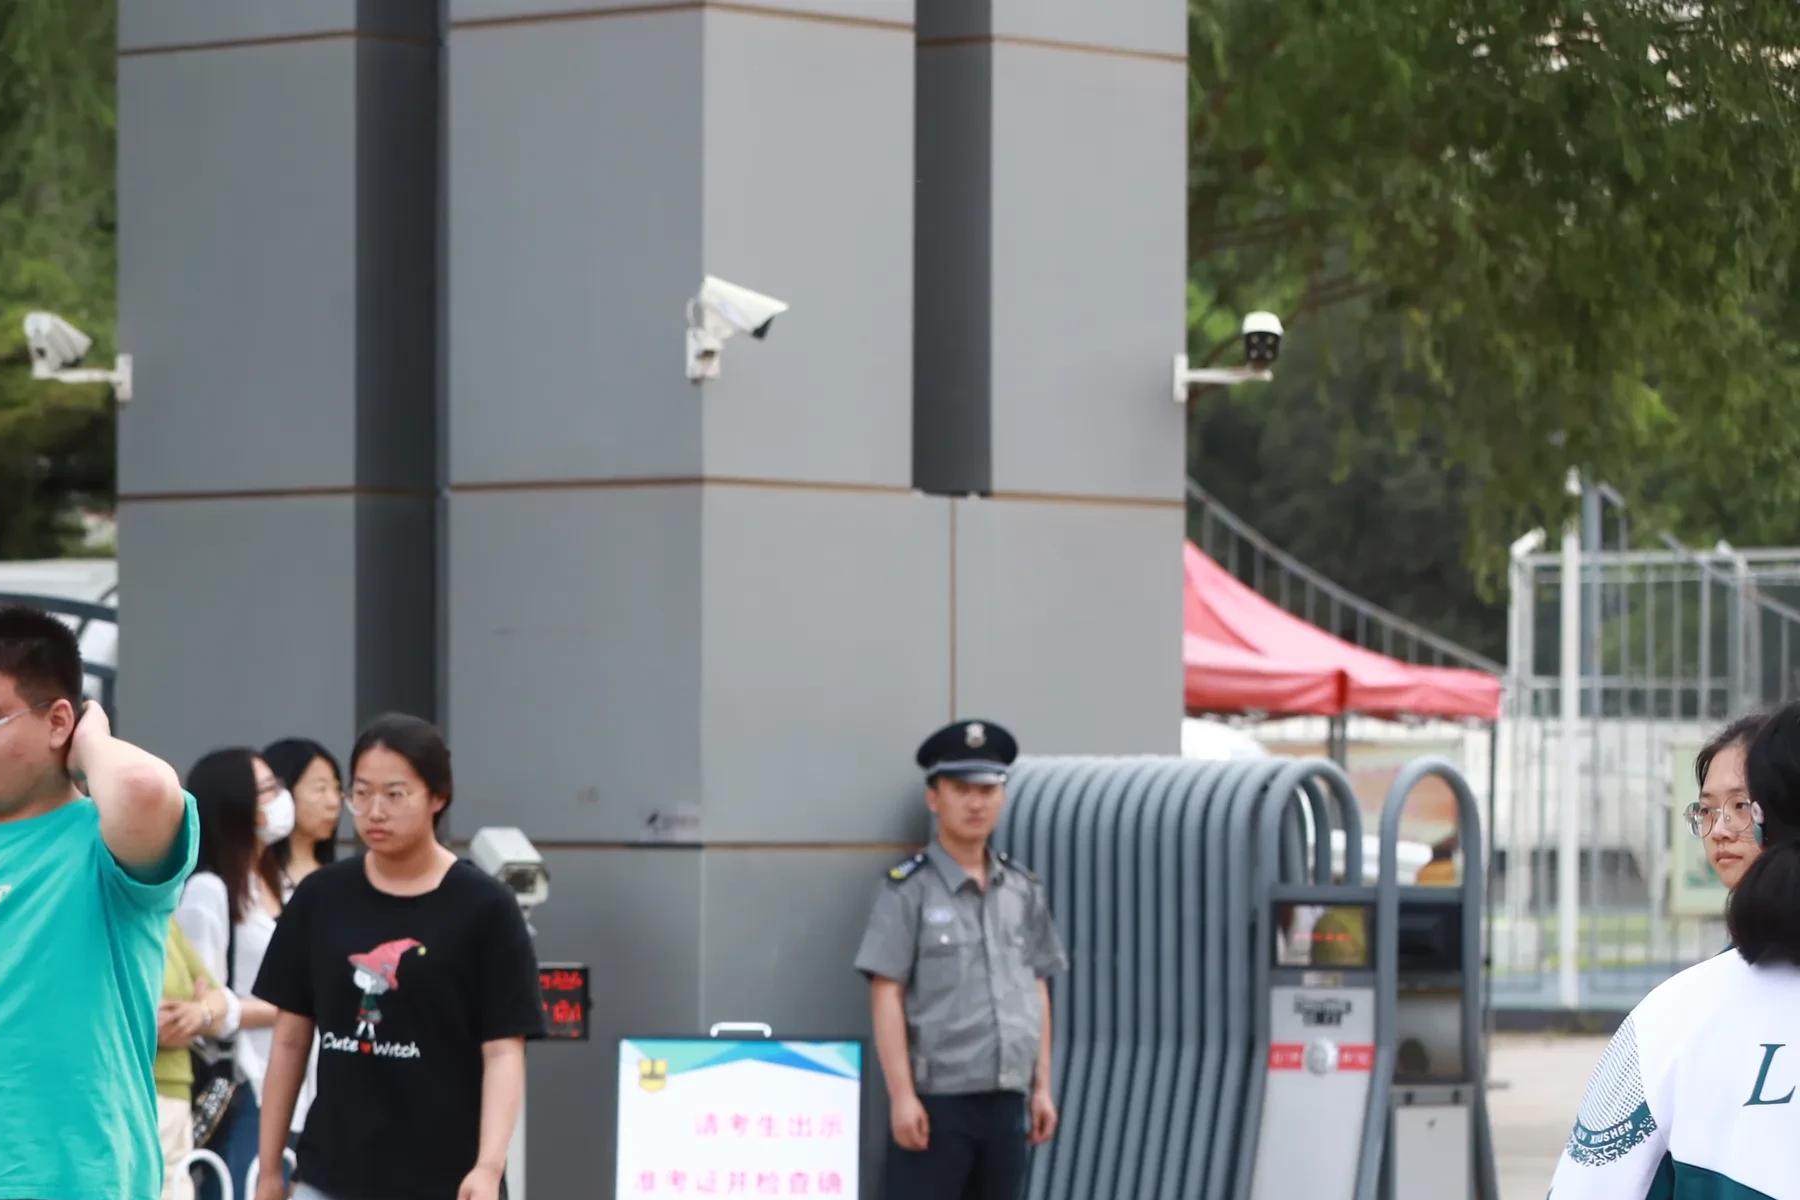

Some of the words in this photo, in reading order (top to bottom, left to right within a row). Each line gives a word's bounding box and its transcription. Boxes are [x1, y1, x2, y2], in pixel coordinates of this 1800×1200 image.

[322, 1032, 359, 1052] Cute
[1742, 1043, 1796, 1107] L
[696, 1113, 844, 1138] 请考生出示
[634, 1169, 843, 1195] 准考证并检查确
